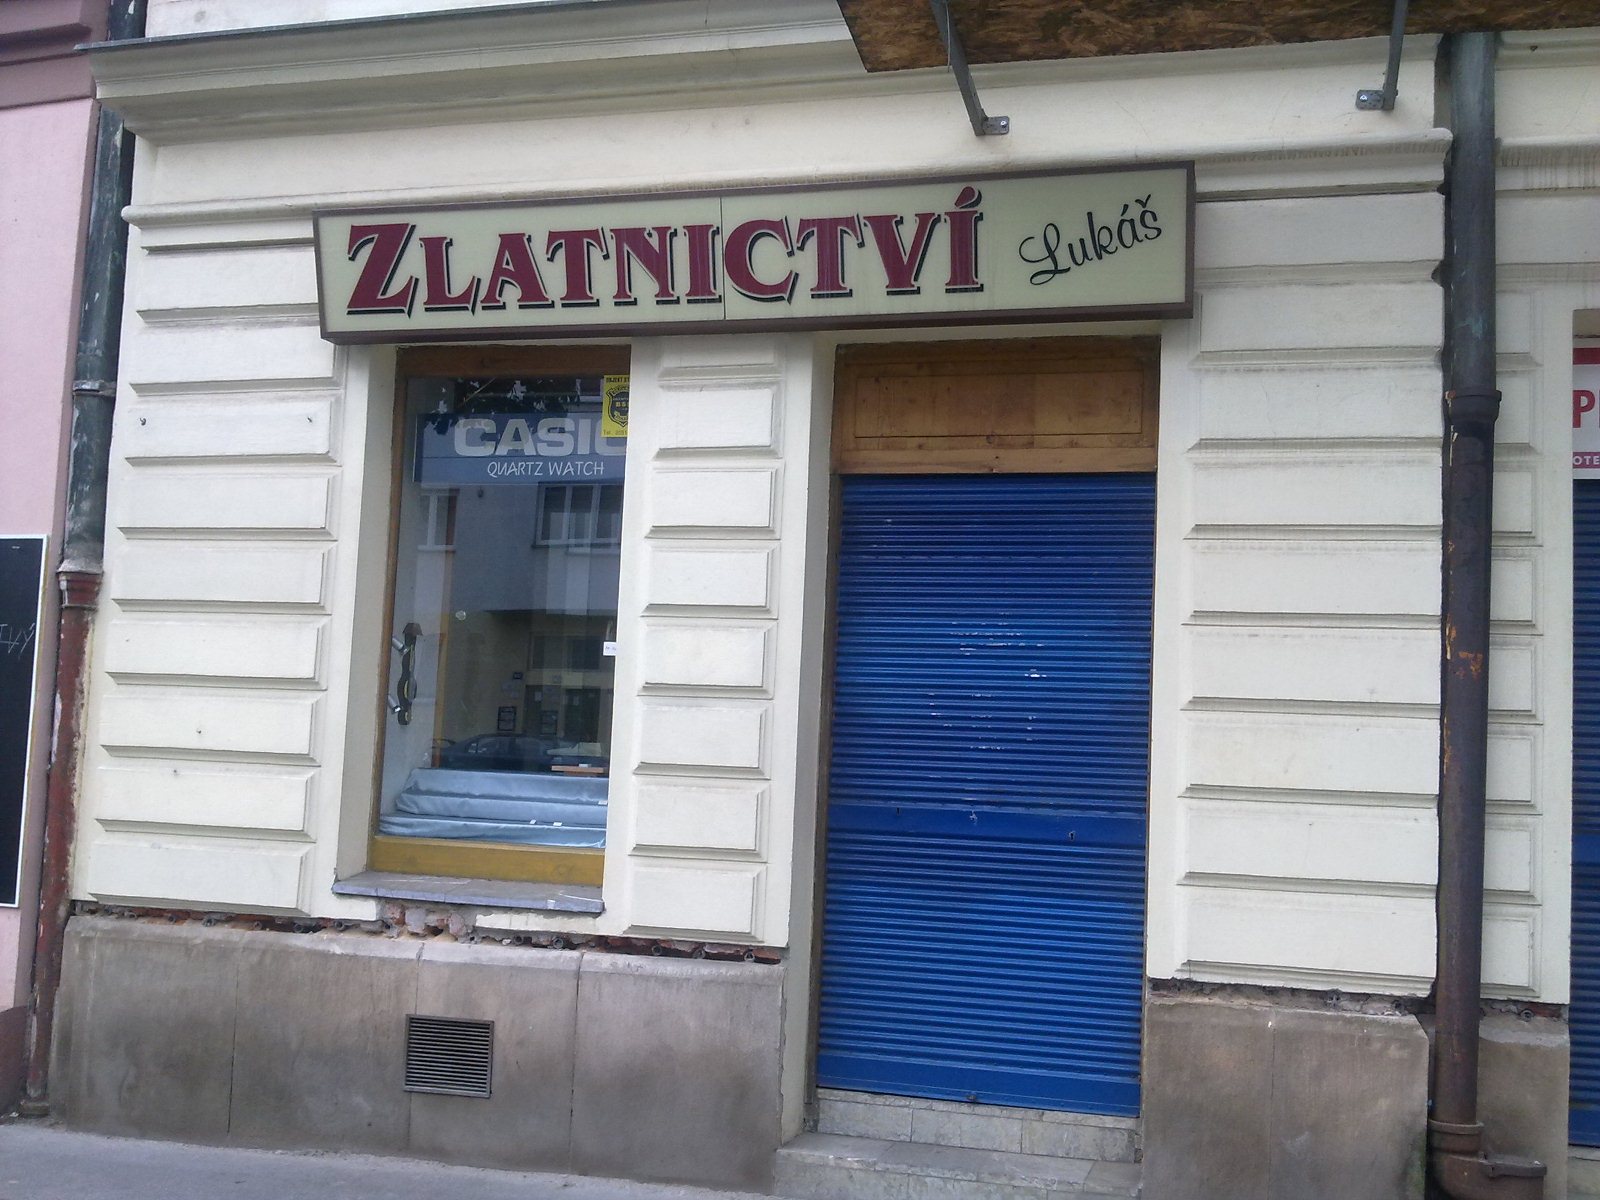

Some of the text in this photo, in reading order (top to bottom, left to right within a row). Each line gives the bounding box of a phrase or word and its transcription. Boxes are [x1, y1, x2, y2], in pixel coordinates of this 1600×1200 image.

[347, 185, 1163, 318] ZLATNICTVÍ Lukáš
[487, 460, 605, 478] QUARTZ WATCH
